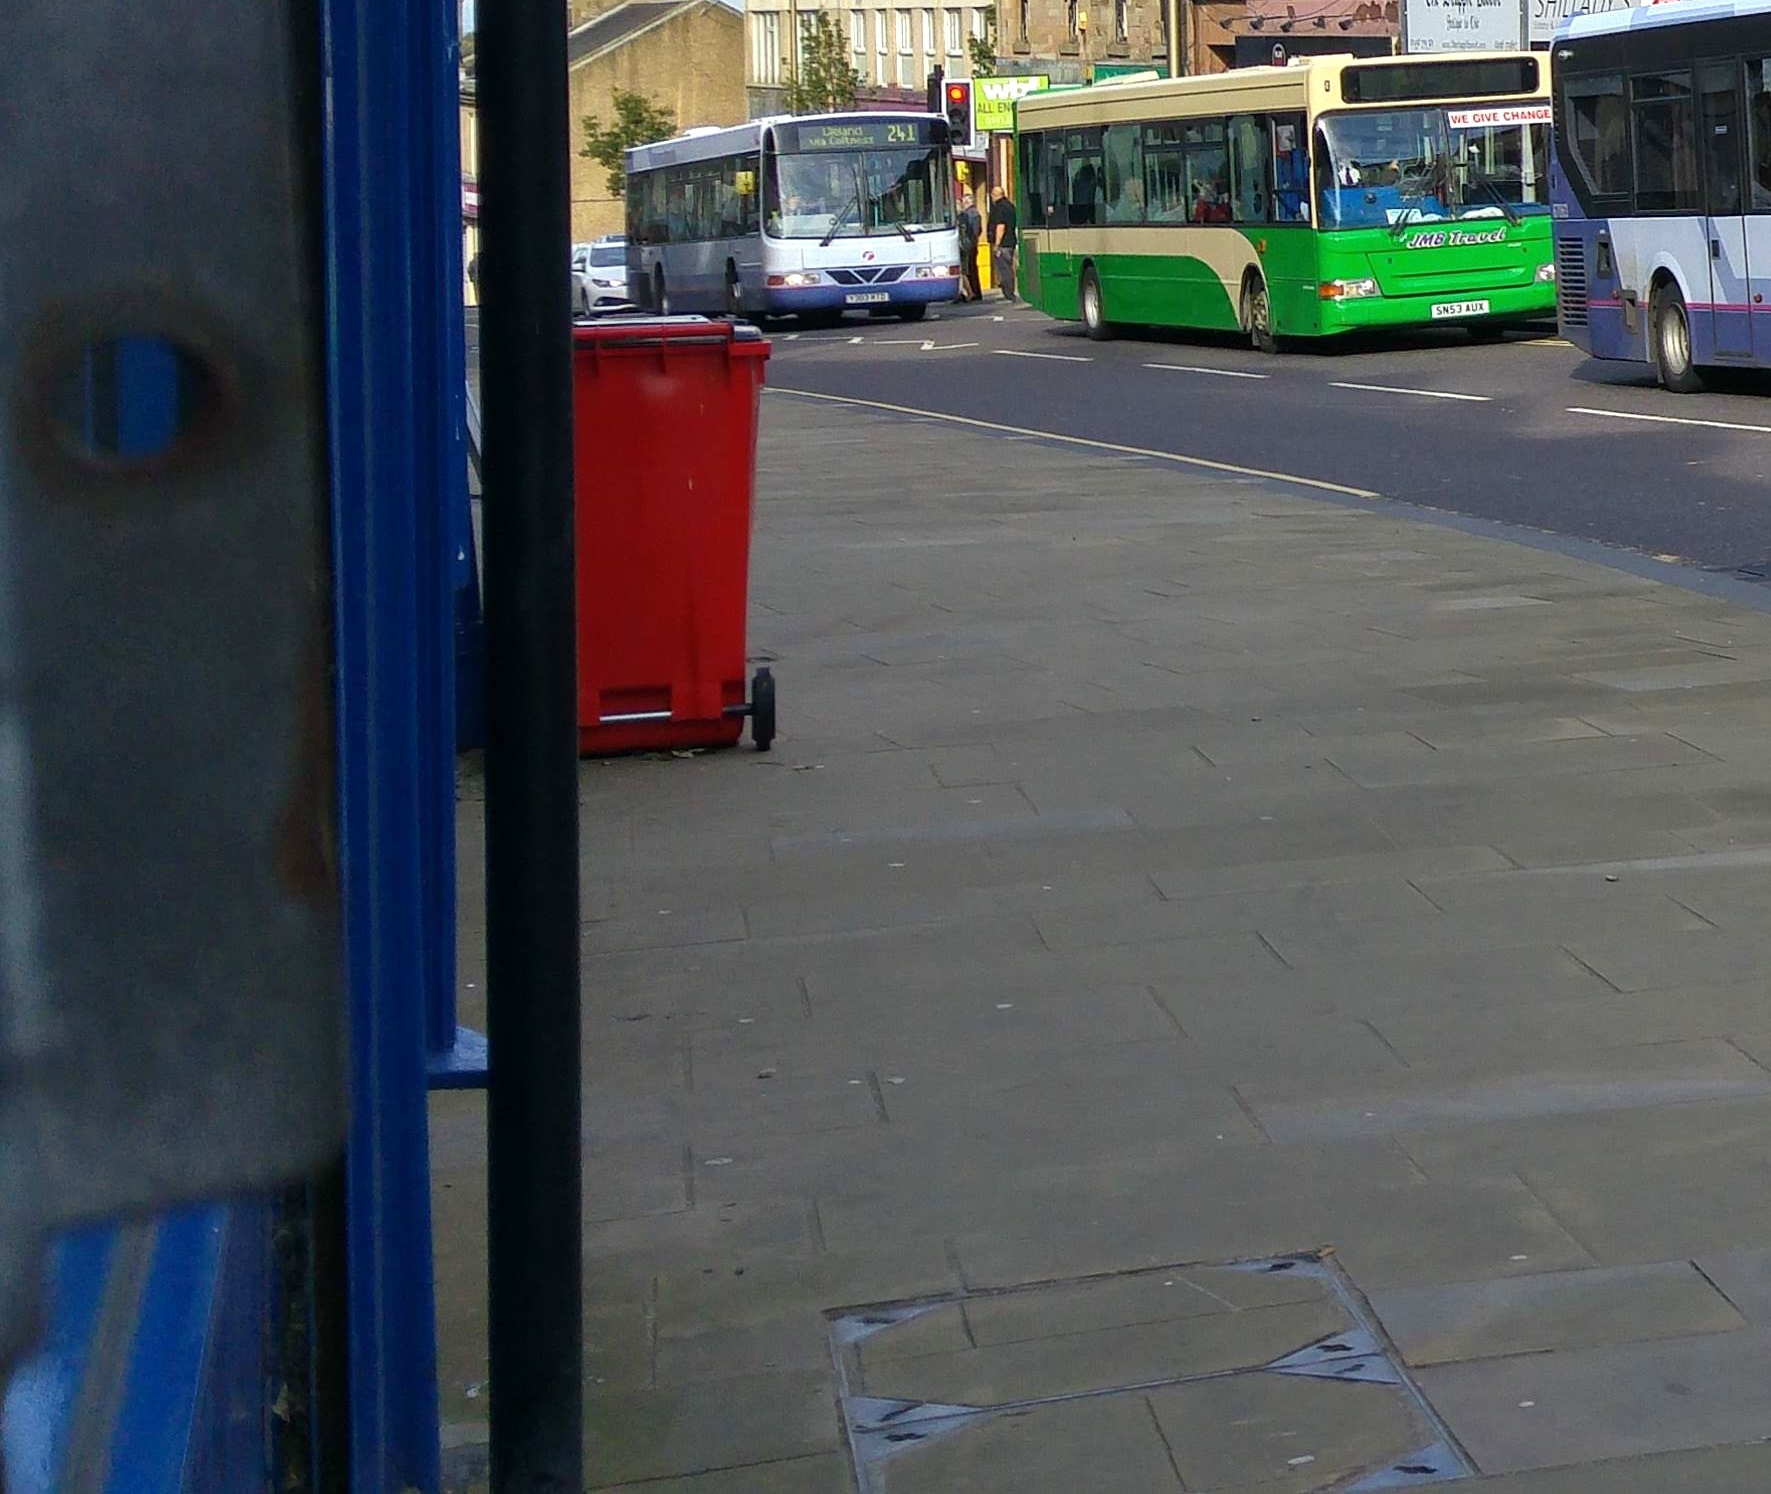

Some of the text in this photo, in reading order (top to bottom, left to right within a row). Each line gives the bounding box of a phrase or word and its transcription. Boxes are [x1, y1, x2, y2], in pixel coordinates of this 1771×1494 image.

[978, 102, 995, 113] ALL
[1451, 109, 1551, 124] WE GIVE CHANGE
[888, 124, 916, 142] 241
[1450, 227, 1506, 246] Travel
[1436, 303, 1485, 315] SN53 AUX
